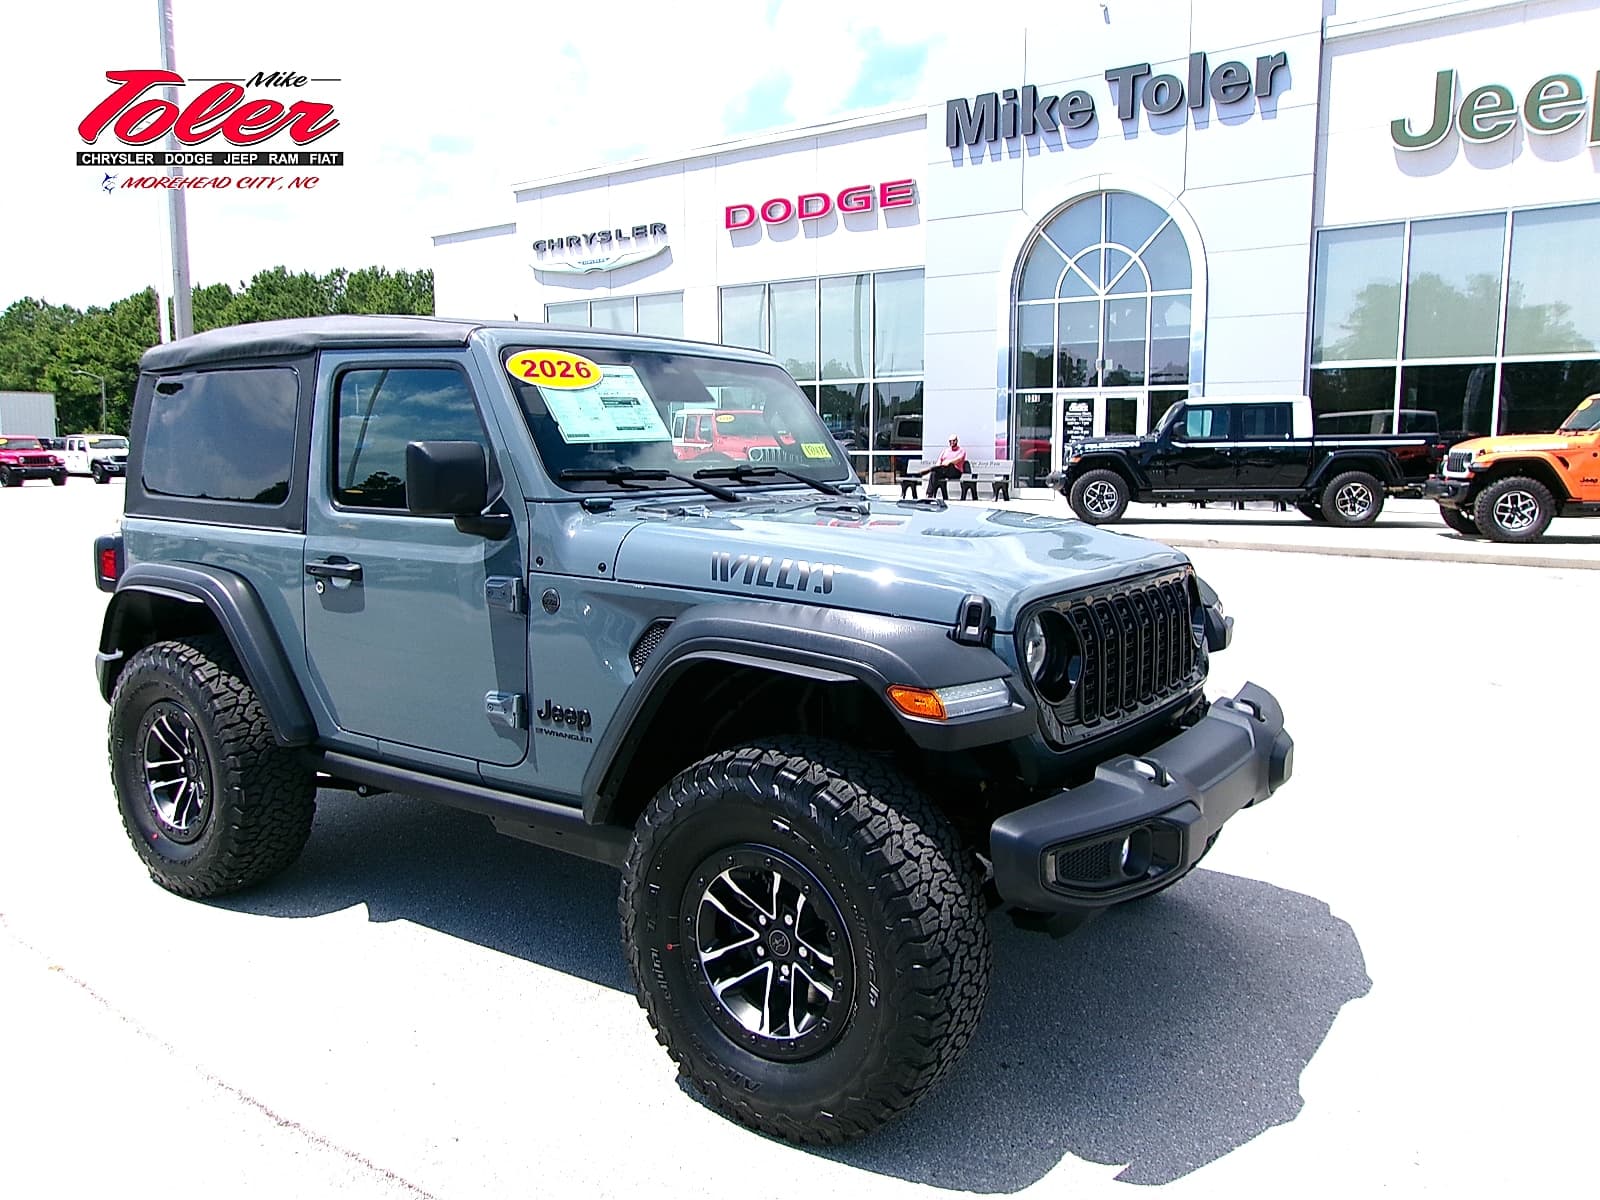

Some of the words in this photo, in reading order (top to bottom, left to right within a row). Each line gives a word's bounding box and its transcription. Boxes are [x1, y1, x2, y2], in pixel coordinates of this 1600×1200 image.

[945, 84, 1095, 148] Mike
[1105, 50, 1288, 121] Toler
[725, 179, 916, 230] DODGE
[532, 222, 668, 252] CHRYSLER
[520, 358, 592, 379] 2026
[711, 551, 842, 595] WILLYS
[536, 698, 592, 732] Jeep
[543, 728, 593, 744] WRANGLER
